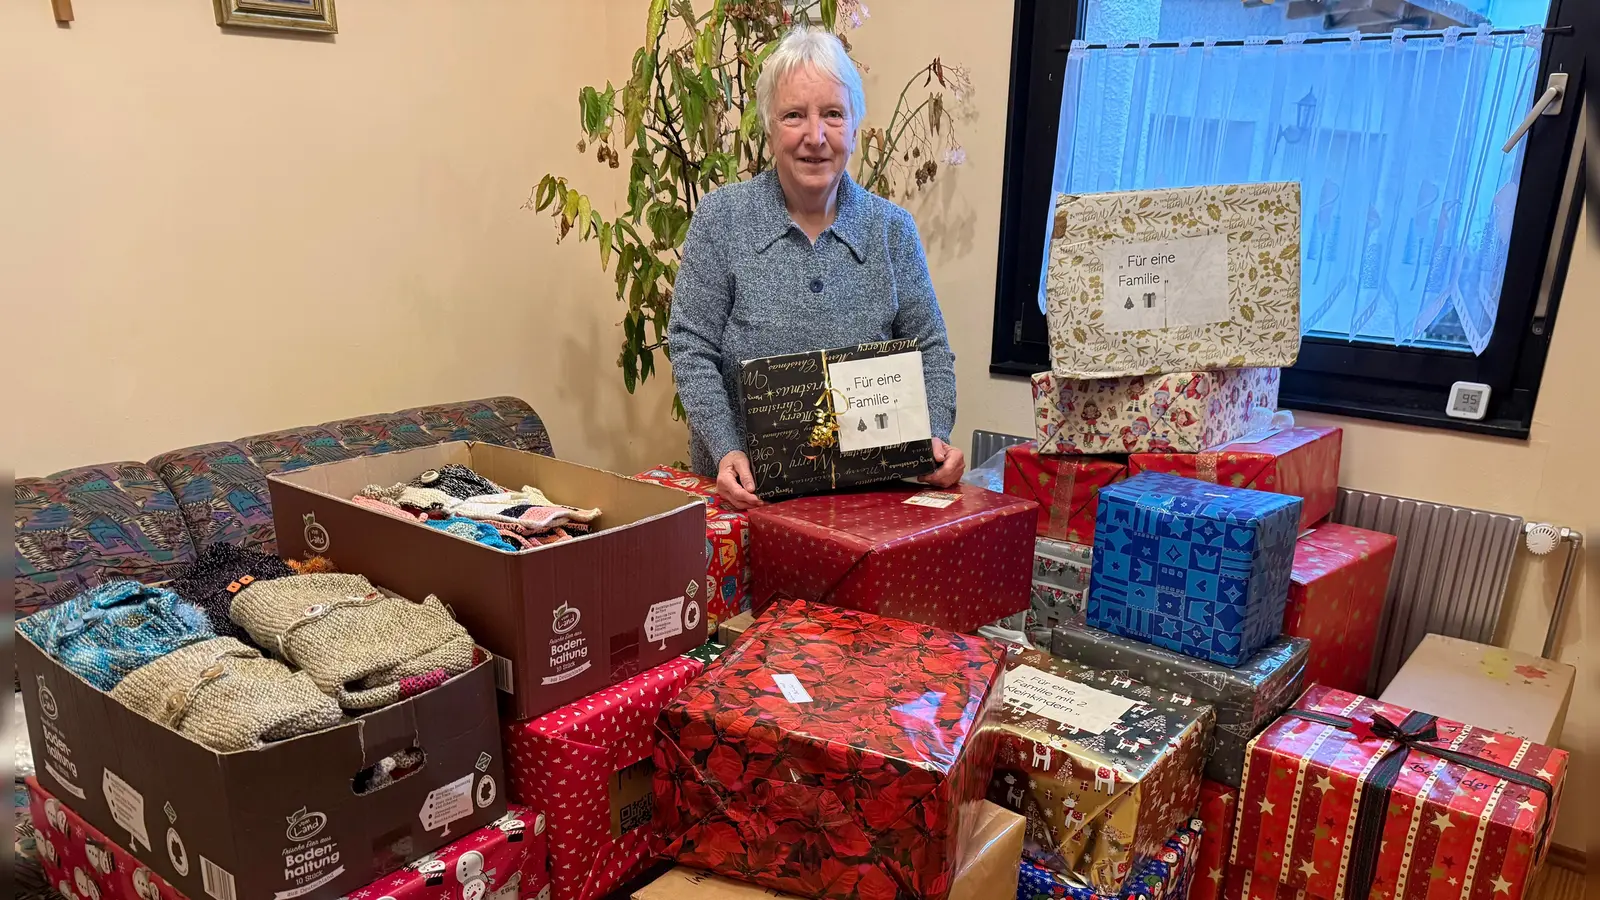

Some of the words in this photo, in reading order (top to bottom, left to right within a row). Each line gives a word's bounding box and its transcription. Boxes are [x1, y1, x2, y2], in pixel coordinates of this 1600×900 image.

[1128, 254, 1148, 268] Für
[1150, 252, 1176, 266] eine
[1118, 273, 1161, 287] Familie
[856, 340, 891, 353] Merry
[768, 358, 818, 373] Christmas
[854, 377, 874, 388] Für
[876, 372, 902, 386] eine
[776, 381, 825, 398] ristmas
[747, 400, 803, 414] Christmas
[849, 394, 890, 409] Familie
[778, 411, 815, 424] Merry
[551, 638, 586, 656] Boden-
[549, 646, 588, 668] haltung
[1013, 678, 1054, 698] Familie
[1056, 693, 1076, 705] mit
[1030, 676, 1050, 688] Für
[1052, 684, 1076, 696] eine
[1004, 684, 1074, 714] Kleinkindern
[294, 818, 319, 837] Land
[286, 842, 338, 868] Boden-
[284, 852, 340, 880] haltung
[296, 878, 304, 886] 10
